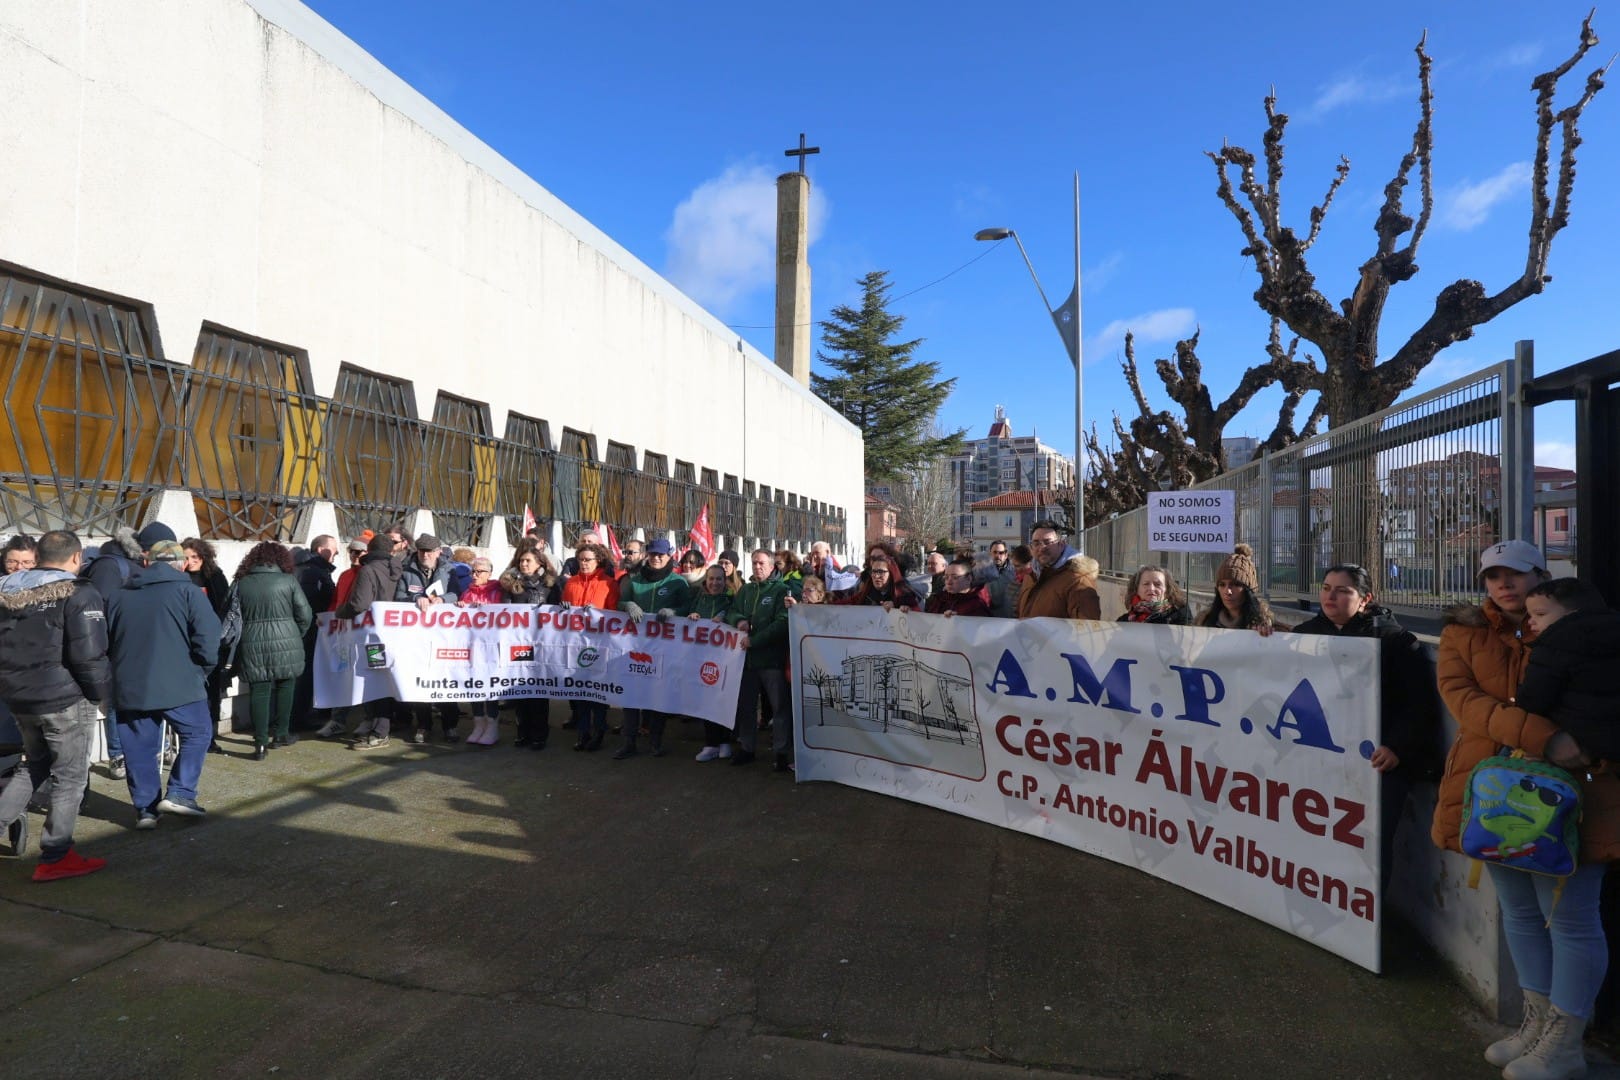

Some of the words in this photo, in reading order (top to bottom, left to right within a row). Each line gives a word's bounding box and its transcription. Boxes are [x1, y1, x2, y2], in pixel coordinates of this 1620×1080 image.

[1159, 498, 1175, 508] NO
[1178, 497, 1221, 508] SOMOS
[1159, 515, 1175, 525] UN
[1178, 515, 1221, 525] BARRIO
[1153, 532, 1167, 542] DE
[1169, 532, 1228, 543] SEGUNDA!
[1495, 545, 1506, 554] T
[383, 607, 530, 629] EDUCACIÓN
[646, 621, 675, 639] DE
[682, 625, 738, 650] LEÓN
[464, 678, 484, 688] de
[490, 677, 558, 688] Personal
[564, 677, 624, 694] Docente
[430, 691, 443, 699] de
[447, 691, 487, 699] centros
[995, 715, 1123, 776] César
[1135, 729, 1366, 850] Álvarez
[997, 770, 1046, 805] C.P.
[1052, 783, 1178, 845] Antonio
[1187, 818, 1376, 922] Valbuena
